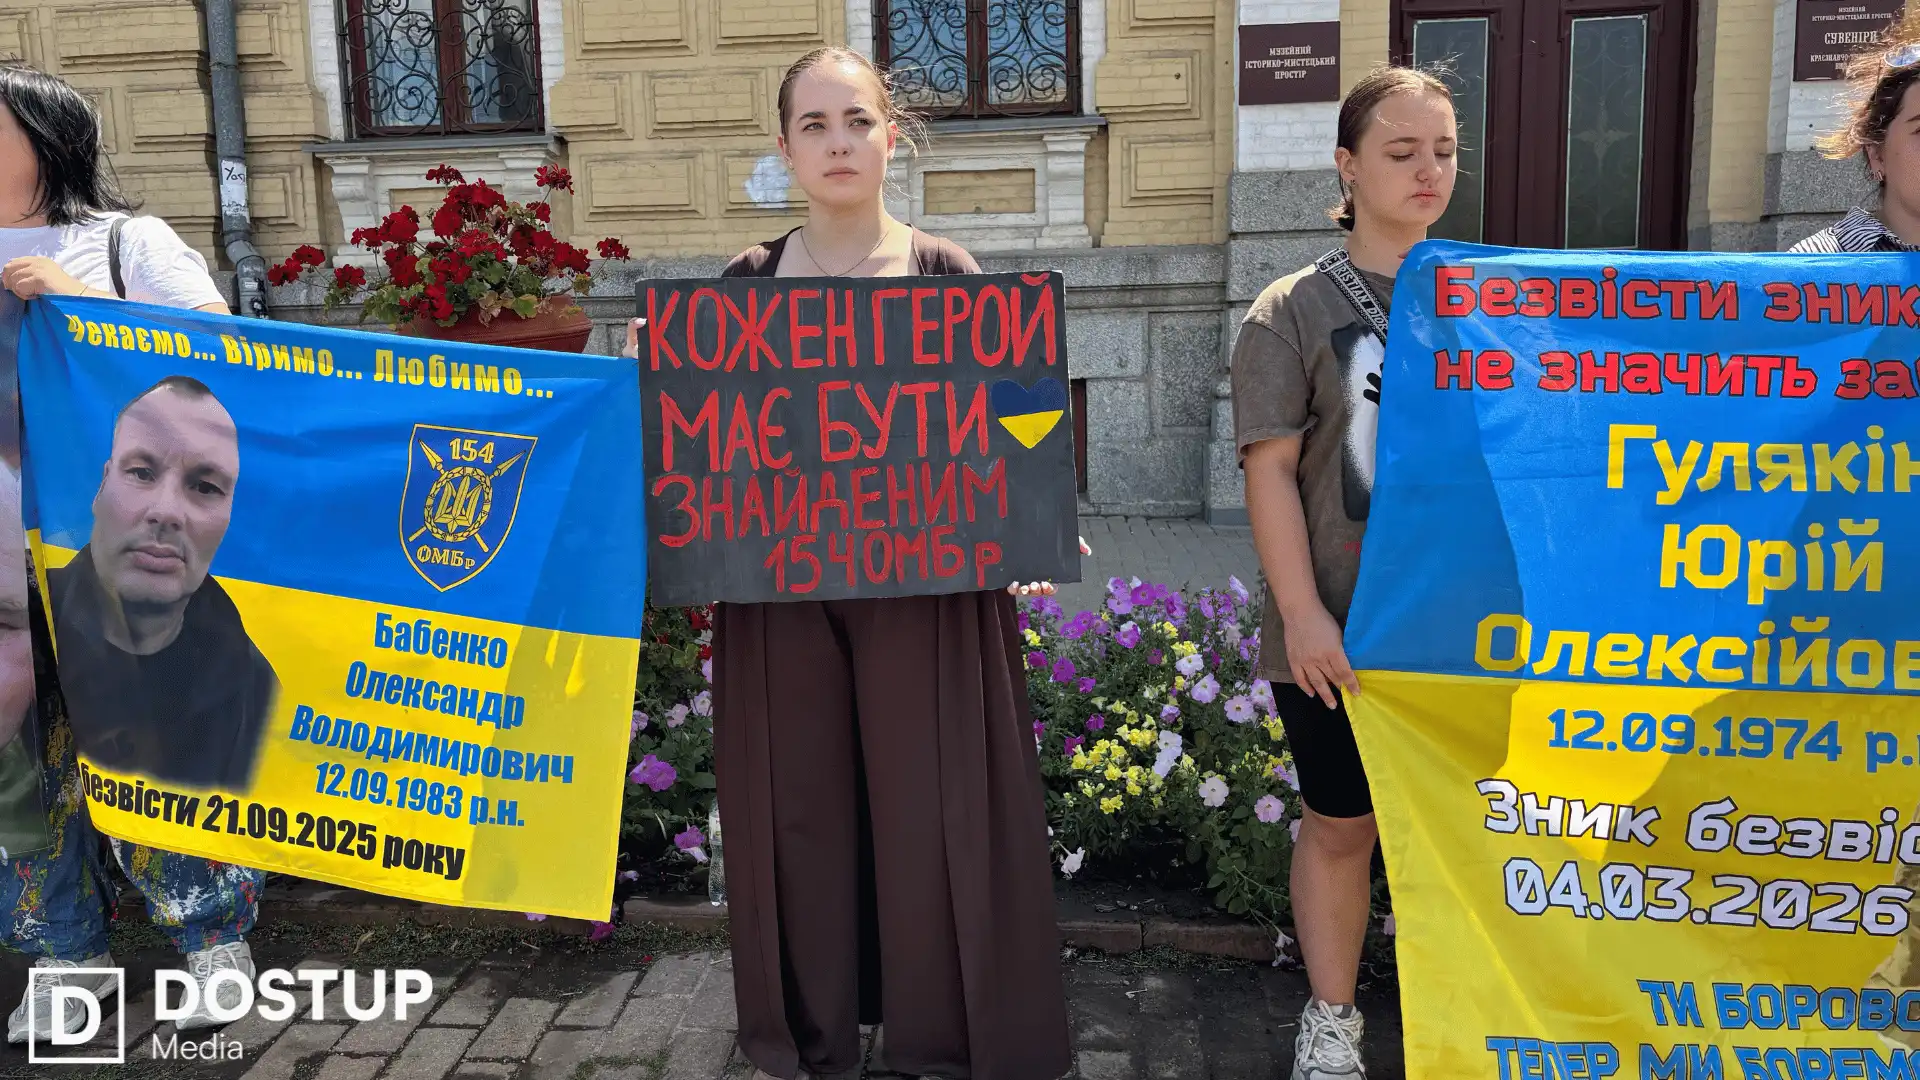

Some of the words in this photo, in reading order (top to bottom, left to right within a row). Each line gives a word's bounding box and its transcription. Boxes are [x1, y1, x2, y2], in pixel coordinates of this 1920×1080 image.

[1245, 56, 1336, 69] ІСТОРИКО-МИСТЕЦЬКИЙ
[1269, 45, 1312, 56] МУЗЕЙНИЙ
[1274, 70, 1307, 80] ПРОСТІР
[647, 288, 858, 373] КОЖЕН
[872, 273, 1057, 367] ГЕРОЙ
[1434, 265, 1739, 322] Безвісти
[1763, 282, 1920, 330] зник
[67, 314, 216, 361] Чекаємо...
[219, 334, 363, 380] Віримо...
[374, 348, 554, 398] Любимо...
[1434, 348, 1514, 392] не
[1537, 350, 1818, 398] значить
[1835, 357, 1920, 399] за
[449, 437, 495, 464] 154
[659, 388, 793, 472] МАЄ
[818, 380, 989, 463] БУТИ
[1607, 423, 1920, 506] Гулякін
[653, 457, 1008, 548] ЗНАЙДЕНИМ
[416, 544, 476, 569] ОМБр
[1659, 518, 1884, 605] Юрій
[374, 612, 508, 669] Бабенко
[345, 660, 525, 730] Олександр
[289, 704, 574, 784] Володимирович
[1547, 708, 1842, 762] 12.09.1974
[1864, 730, 1920, 773] р.
[80, 762, 200, 828] безвісти
[202, 794, 377, 860] 21.09.2025
[382, 834, 466, 881] року
[315, 761, 464, 820] 12.09.1983
[469, 794, 525, 827] р.н.
[1474, 777, 1661, 847] Зник
[1503, 857, 1915, 936] 04.03.2026
[1636, 979, 1705, 1028] ТИ
[1485, 1036, 1620, 1080] ТЕПЕР
[1638, 1043, 1724, 1080] МИ
